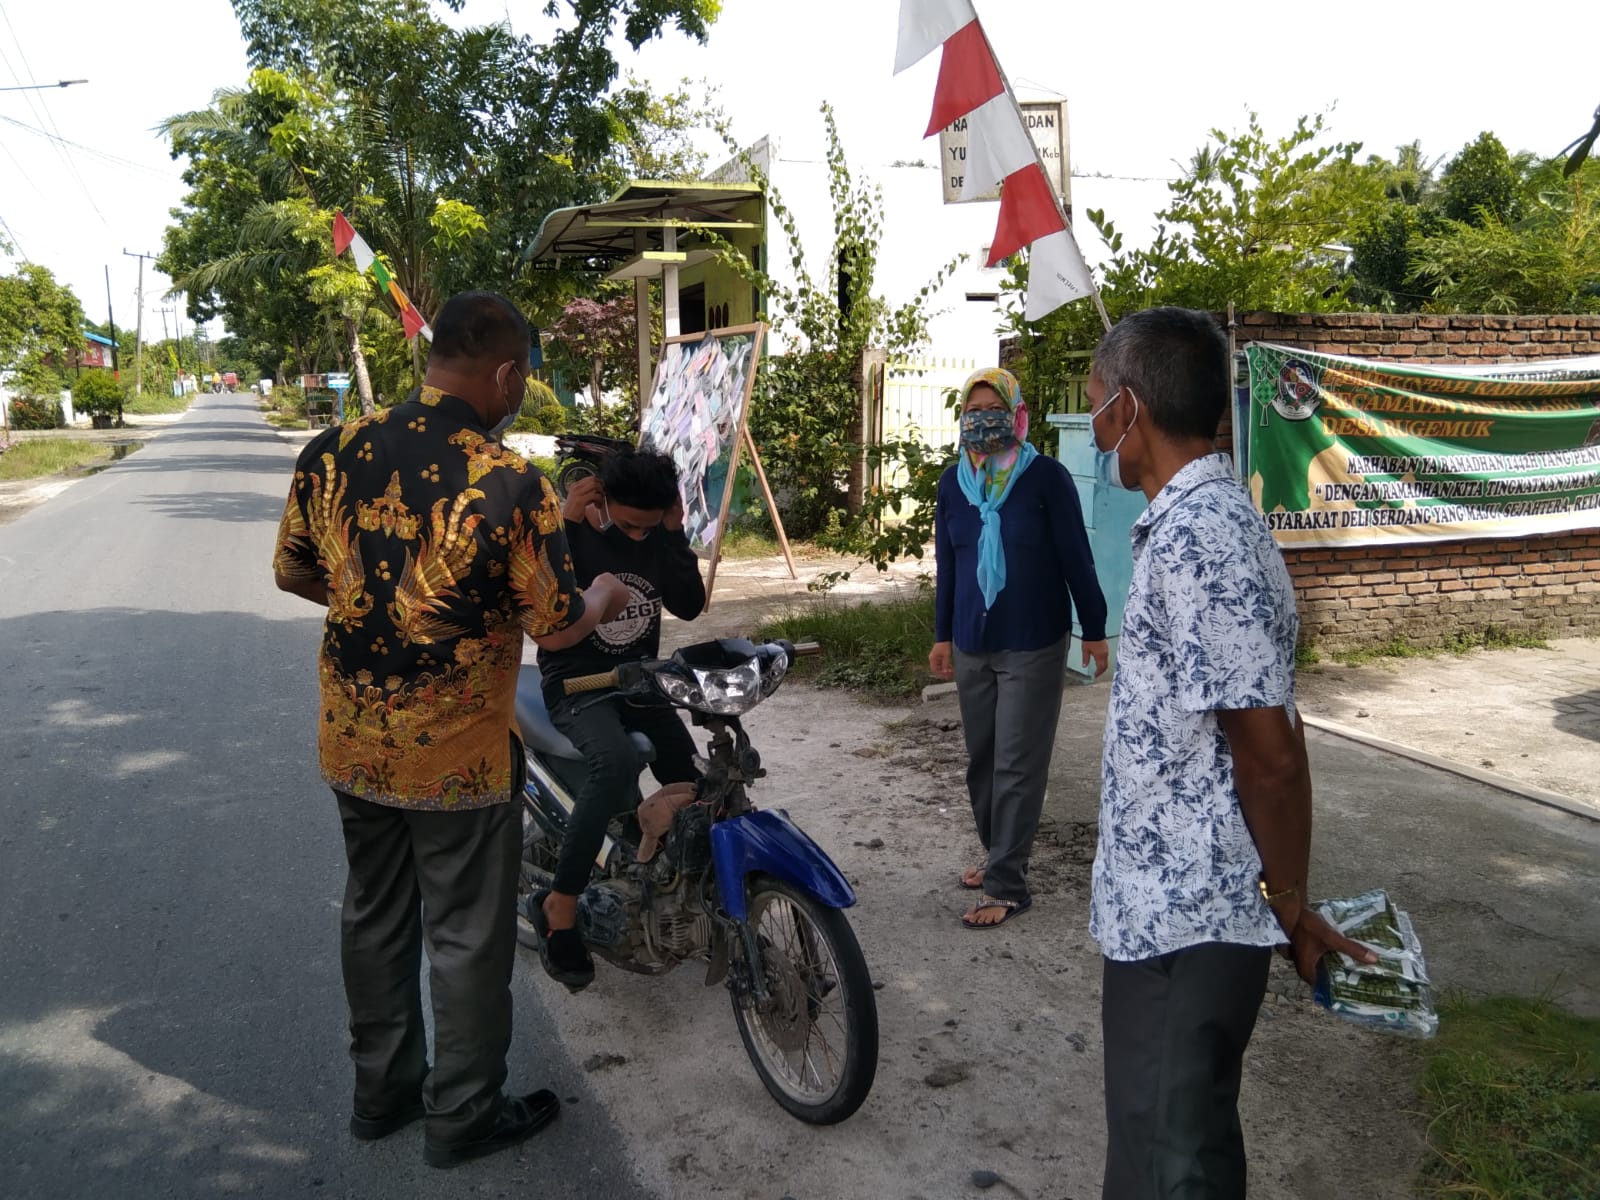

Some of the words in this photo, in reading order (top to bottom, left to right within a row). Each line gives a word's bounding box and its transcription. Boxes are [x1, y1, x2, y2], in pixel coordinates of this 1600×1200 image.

[1322, 416, 1382, 437] DESA
[1347, 456, 1419, 474] MARHABAN
[1421, 457, 1438, 474] YA
[1440, 455, 1504, 474] RAMADHAN
[1507, 453, 1538, 471] 1442H
[1540, 448, 1571, 468] YANG
[1325, 483, 1382, 501] DENGAN
[1383, 481, 1451, 500] RAMADHAN
[1453, 481, 1482, 497] KITA
[1486, 474, 1563, 496] TINGKATKAN
[1565, 472, 1597, 490] IMAN
[1341, 510, 1367, 527] DELI
[1371, 508, 1431, 526] SERDANG
[1434, 506, 1464, 523] YANG
